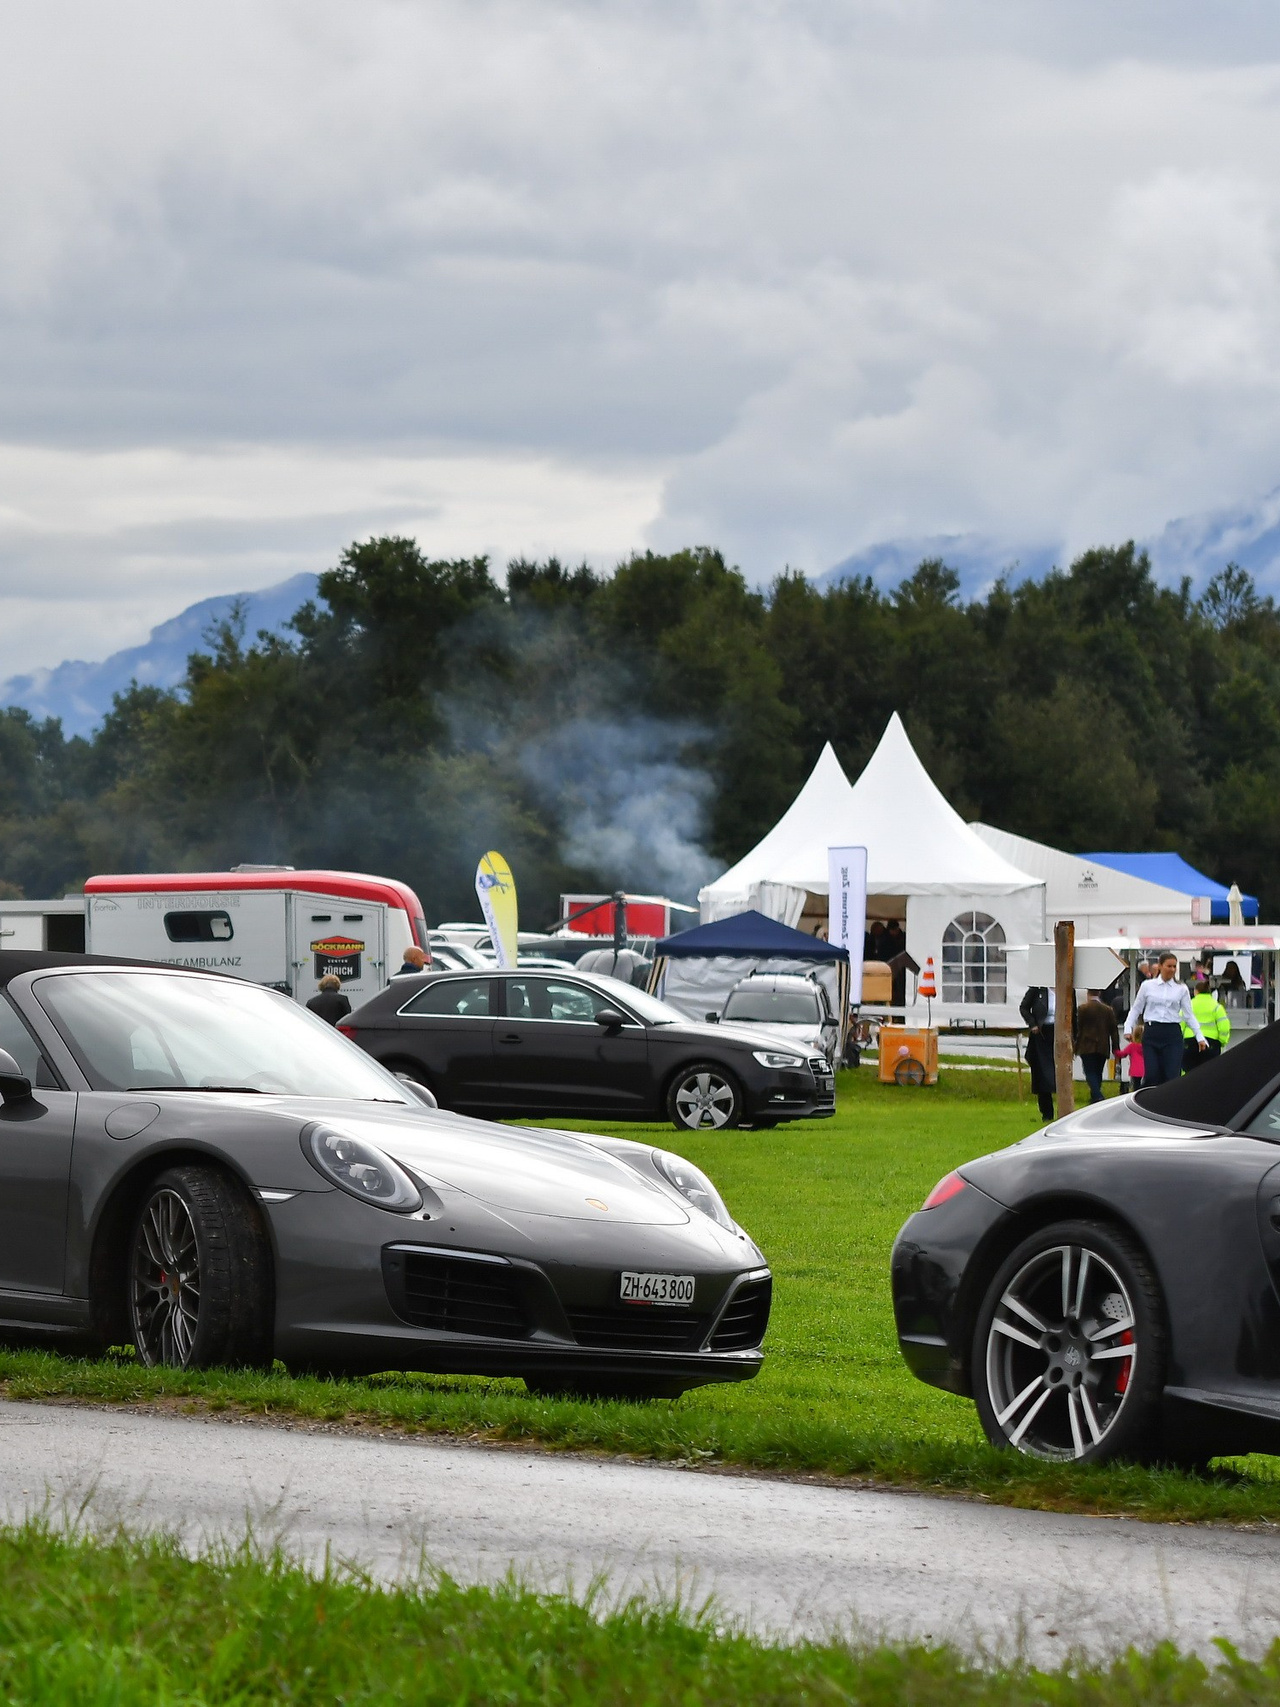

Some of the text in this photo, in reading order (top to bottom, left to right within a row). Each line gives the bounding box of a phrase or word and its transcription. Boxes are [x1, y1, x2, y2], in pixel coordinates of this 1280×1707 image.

[137, 895, 241, 910] INTERHORSE
[311, 943, 365, 951] BÖCKMANN
[322, 965, 354, 976] ZÜRICH
